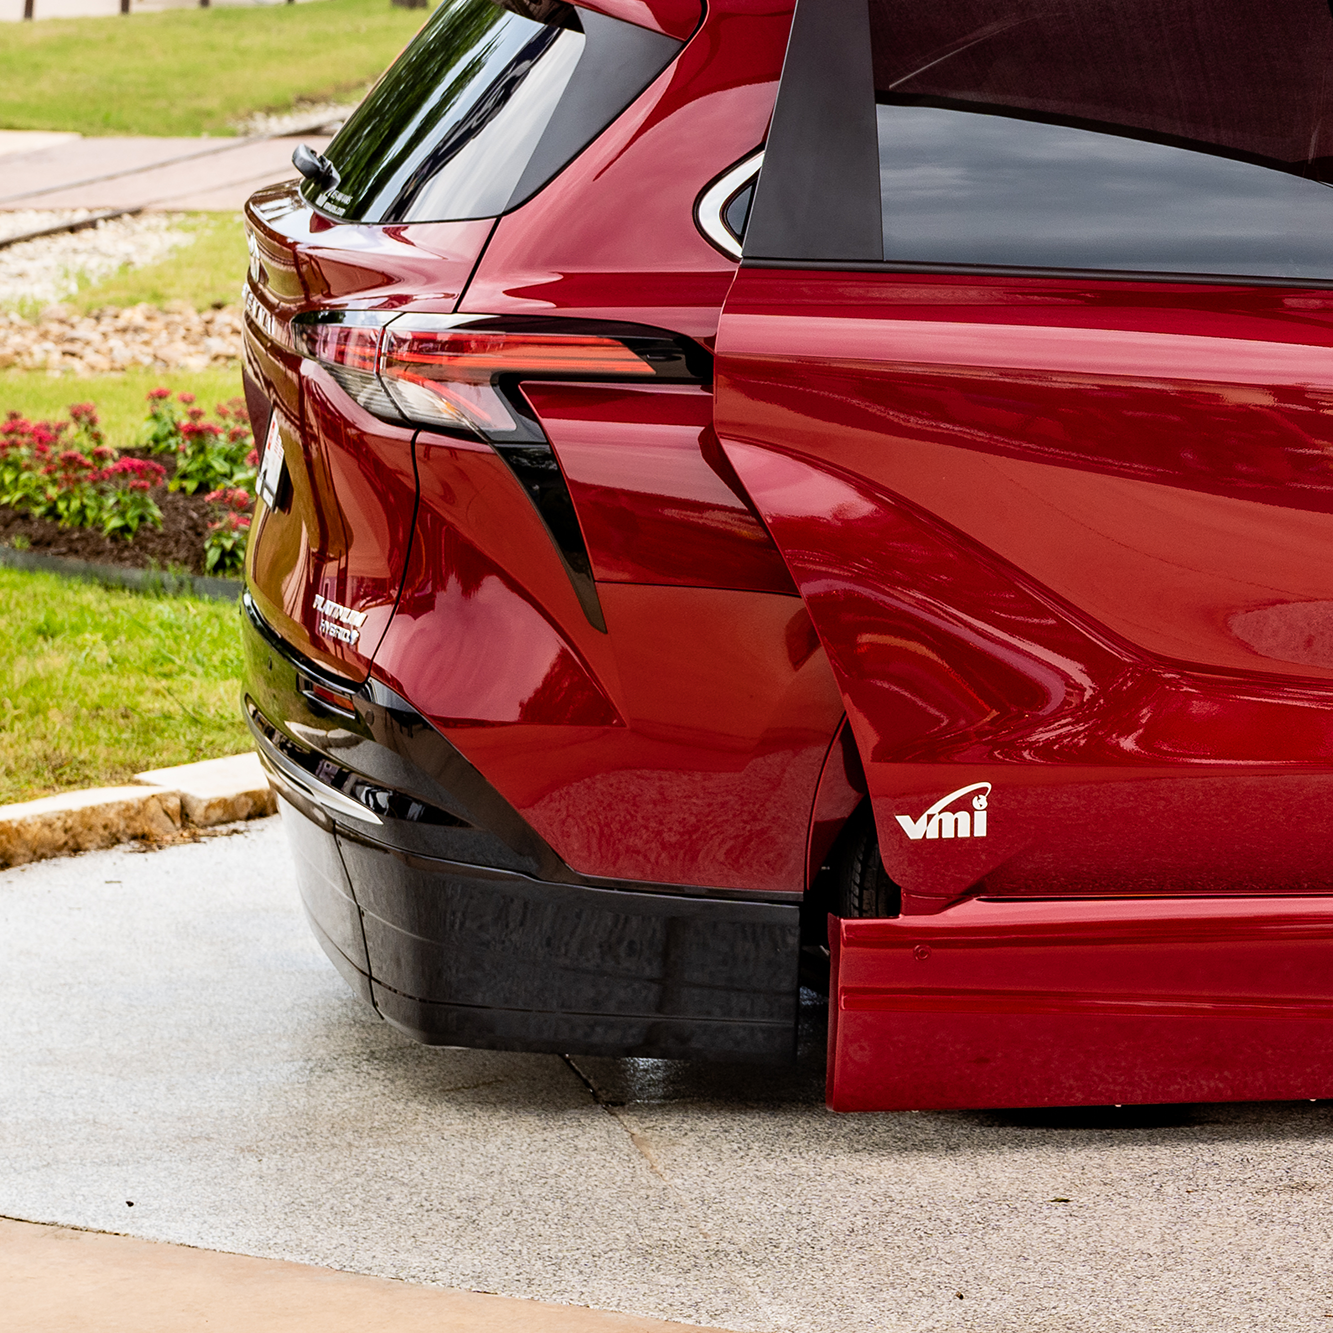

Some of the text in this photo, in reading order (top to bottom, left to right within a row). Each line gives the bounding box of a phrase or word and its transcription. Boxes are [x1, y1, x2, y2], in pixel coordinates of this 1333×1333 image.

[312, 594, 368, 628] PLATINUM
[320, 619, 351, 644] HYBRID
[895, 782, 992, 840] vmi
